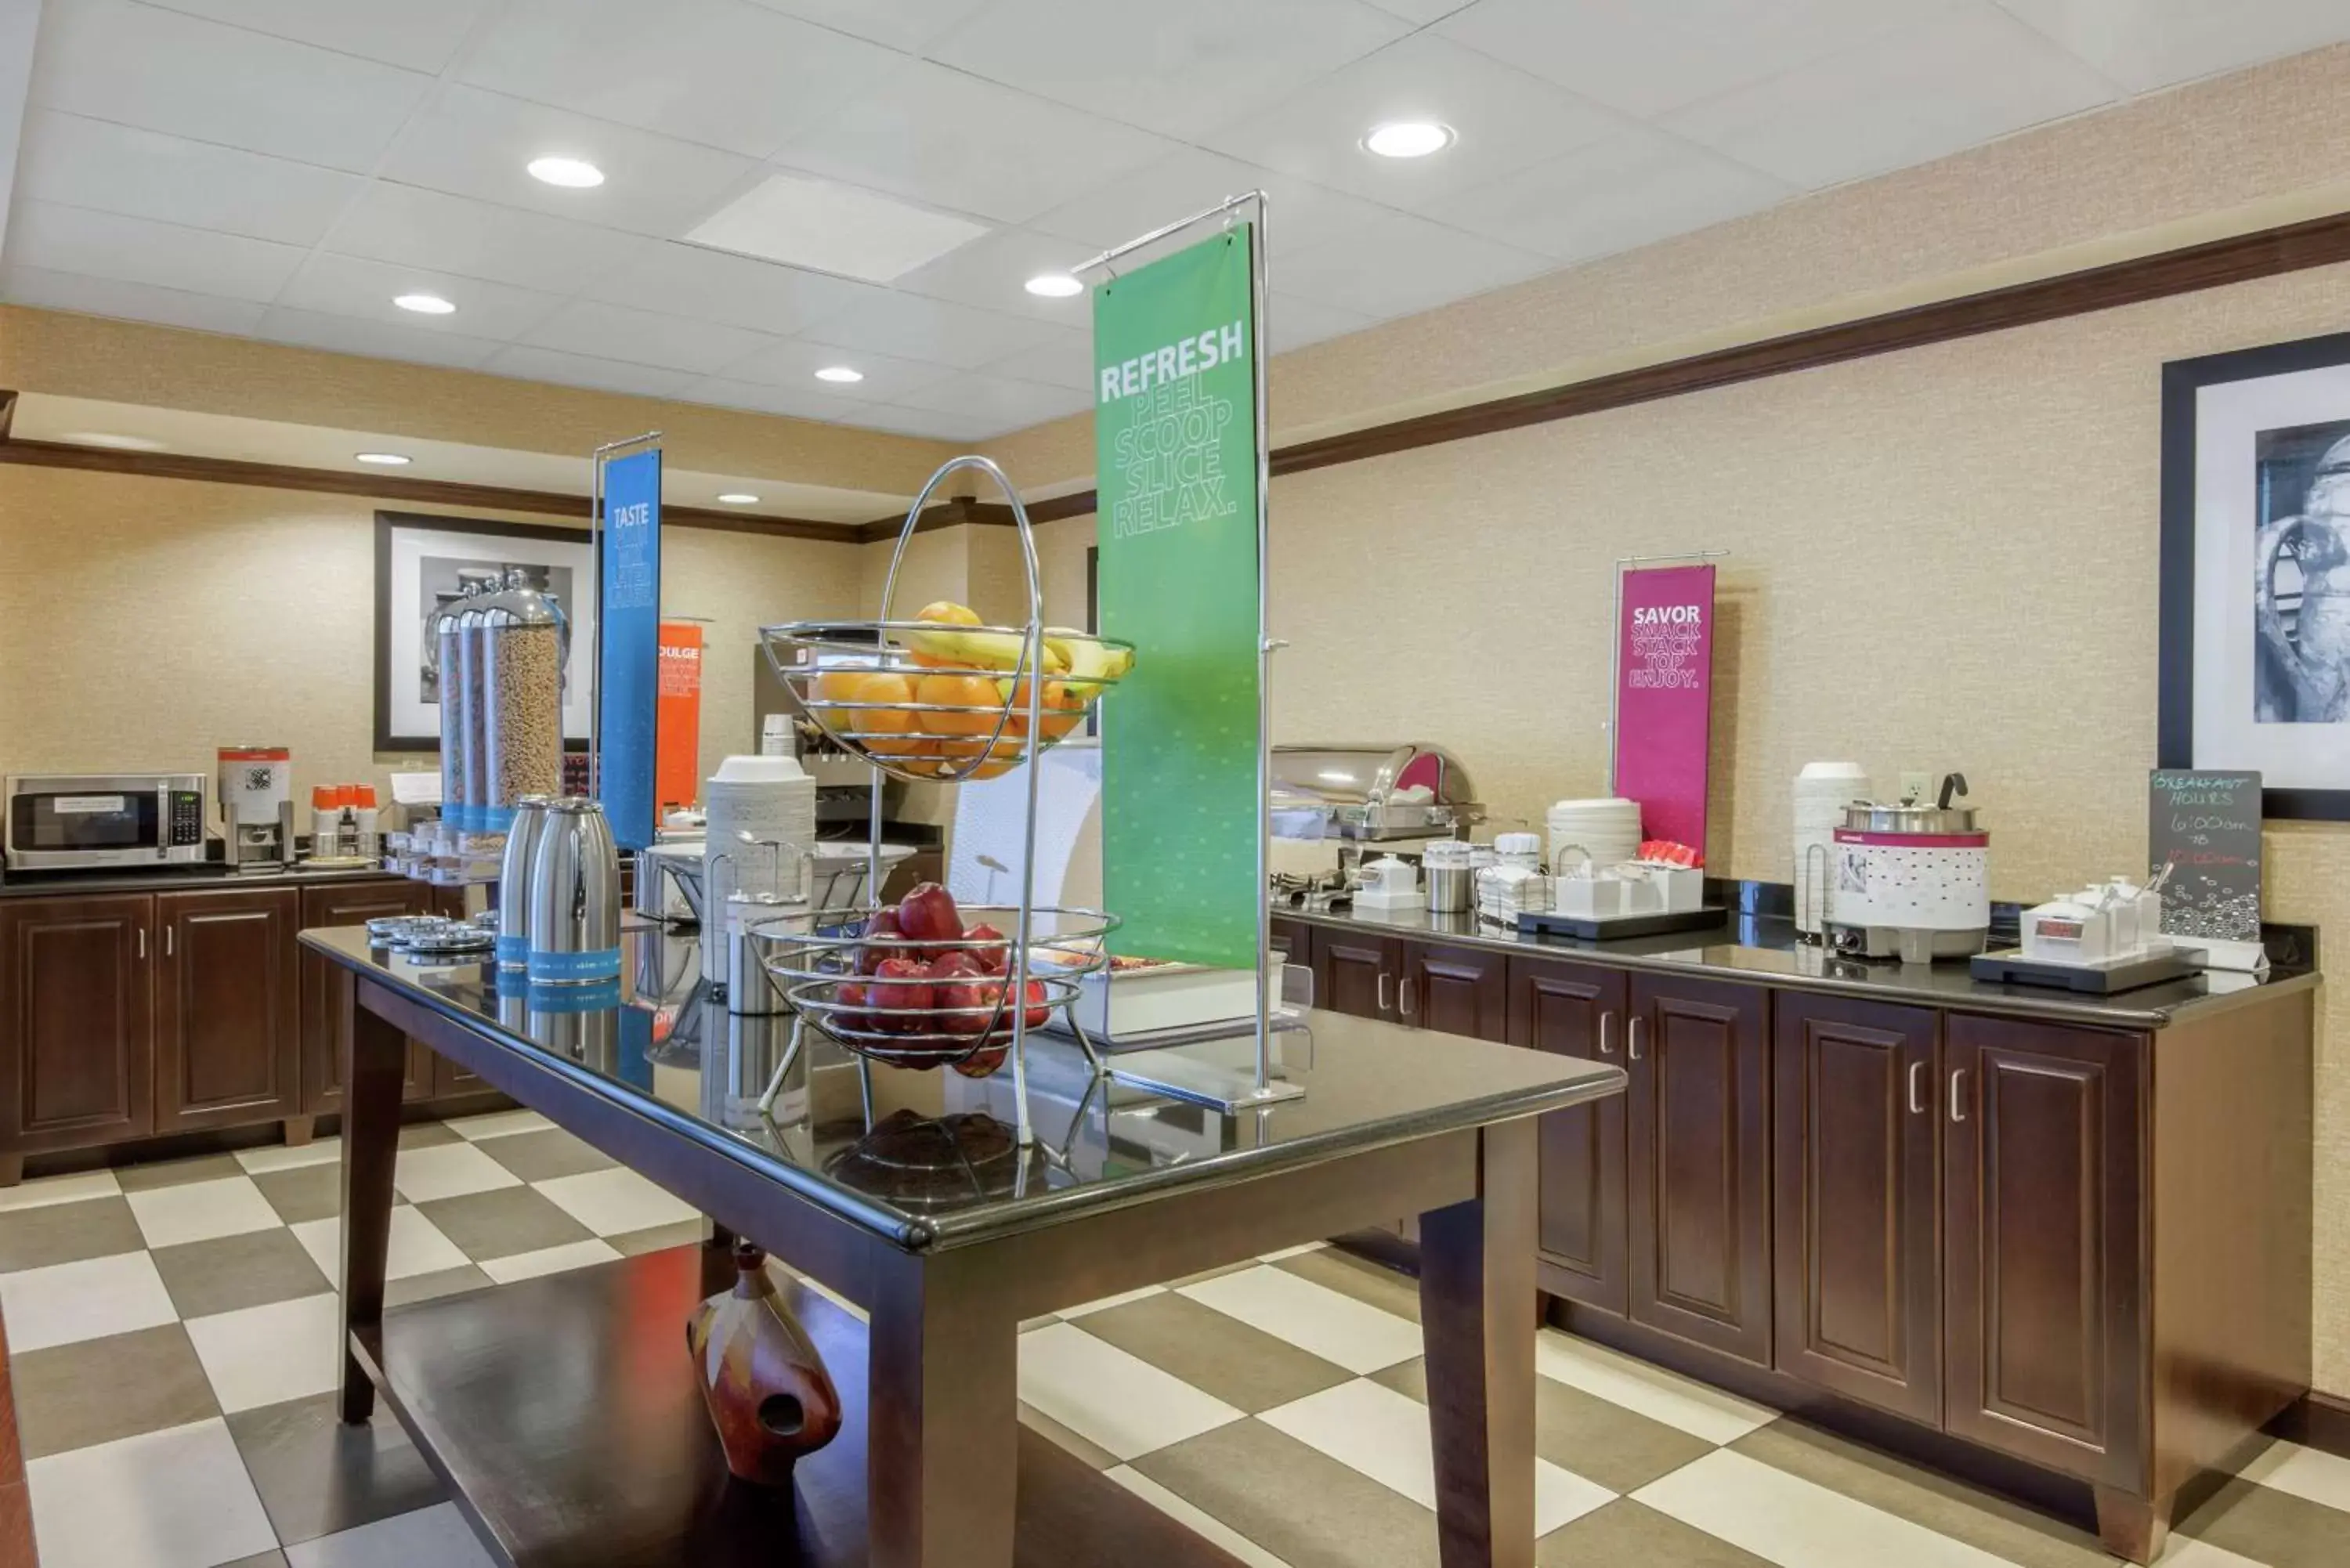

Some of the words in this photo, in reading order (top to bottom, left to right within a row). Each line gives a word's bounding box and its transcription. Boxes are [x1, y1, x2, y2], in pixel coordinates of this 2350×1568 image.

[1101, 320, 1243, 403] REFRESH
[1131, 370, 1213, 428] PEEL
[1115, 399, 1233, 469] SCOOP
[1126, 439, 1224, 498] SLICE
[614, 502, 649, 529] TASTE
[1114, 475, 1237, 539] RELAX.
[1633, 605, 1701, 623] SAVOR
[660, 646, 699, 658] DULGE
[1632, 638, 1697, 656] STACK
[1645, 652, 1684, 670] TOP
[2169, 791, 2233, 806] HOURS
